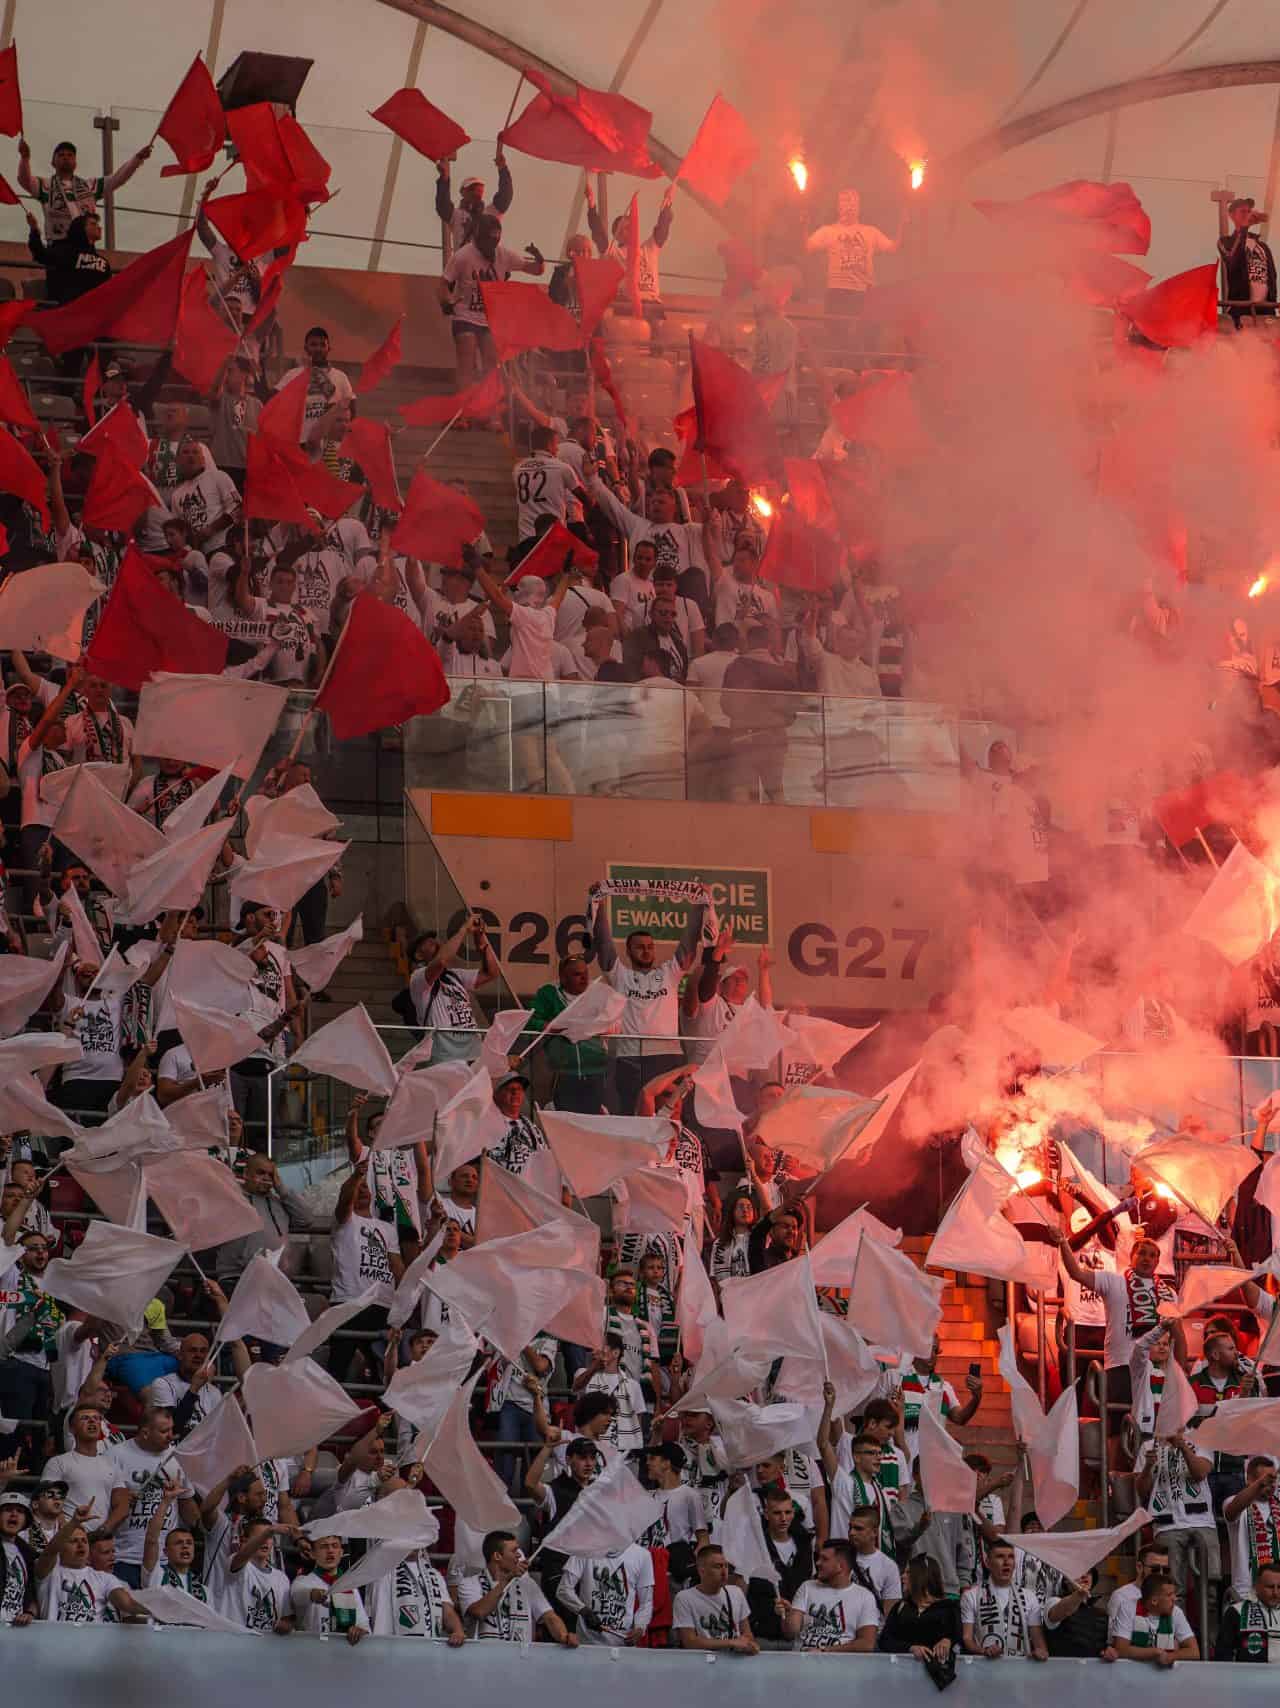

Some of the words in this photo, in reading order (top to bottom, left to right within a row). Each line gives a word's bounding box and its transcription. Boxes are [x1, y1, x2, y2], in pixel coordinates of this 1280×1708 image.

[517, 471, 546, 504] 82
[607, 880, 641, 889] LEGIA
[616, 910, 764, 932] EWAKUYJNE
[788, 922, 930, 979] G27
[360, 1253, 389, 1270] LEGI
[131, 1501, 173, 1517] LEGO
